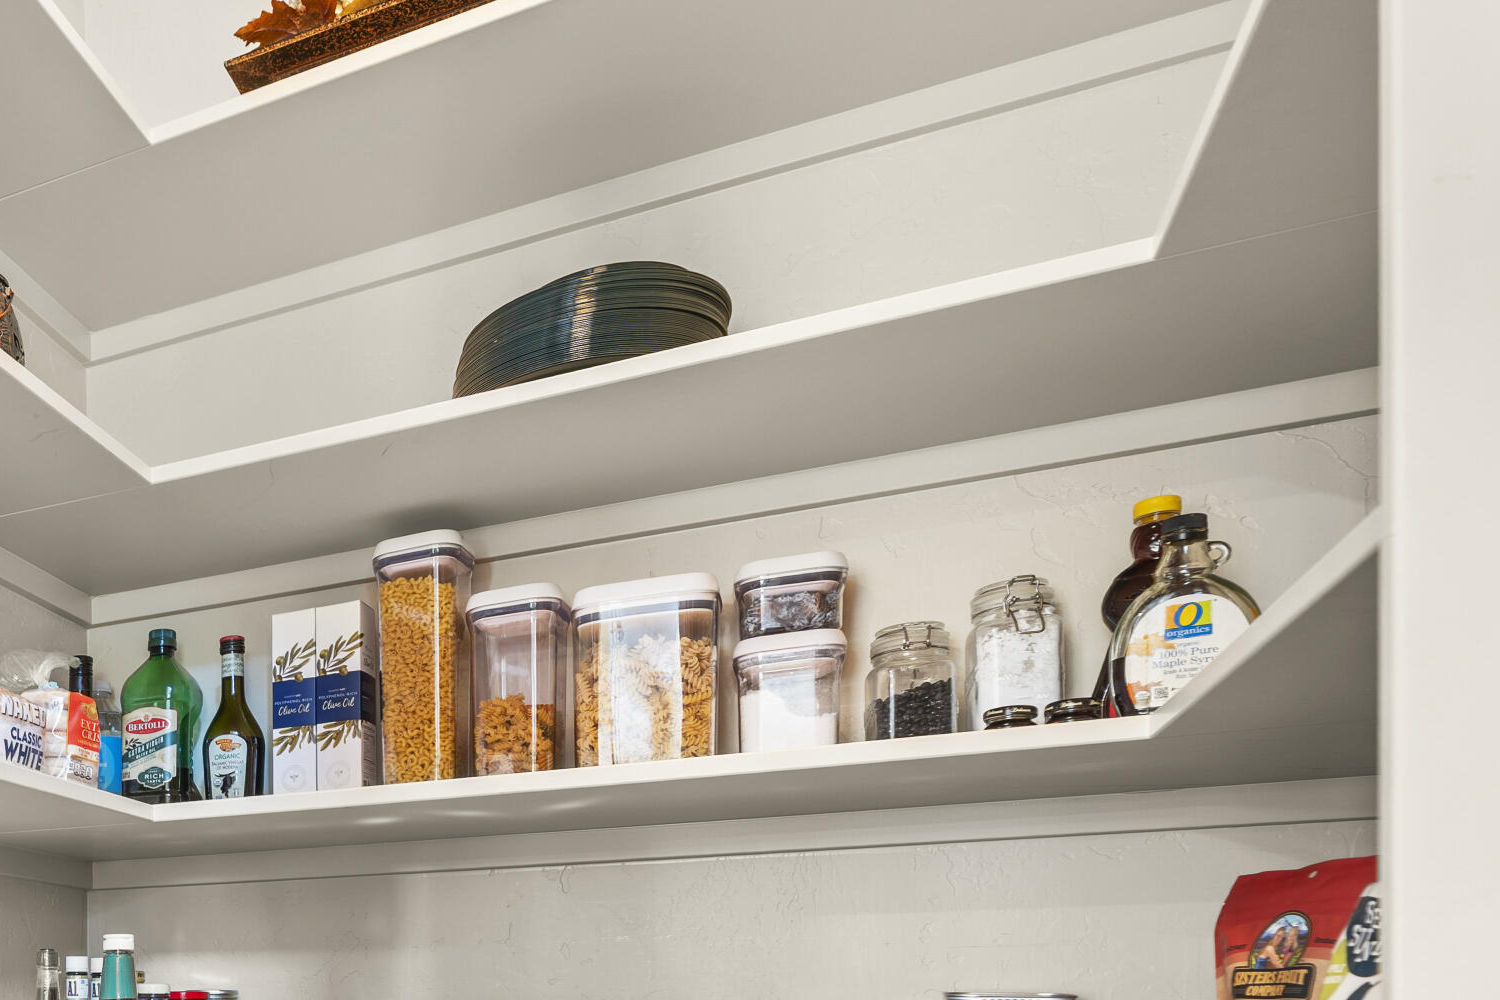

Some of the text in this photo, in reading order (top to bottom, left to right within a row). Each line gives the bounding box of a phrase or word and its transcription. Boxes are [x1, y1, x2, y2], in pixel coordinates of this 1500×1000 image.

[1166, 626, 1211, 638] organics
[1190, 646, 1219, 656] Pure
[1152, 659, 1187, 669] Maple
[278, 702, 310, 716] Olive Oil
[322, 696, 355, 711] Olive Oil
[128, 720, 165, 731] BERTOLLI
[10, 726, 43, 749] CLASSIC
[3, 738, 44, 772] WHITE
[1276, 969, 1309, 985] FRUIT
